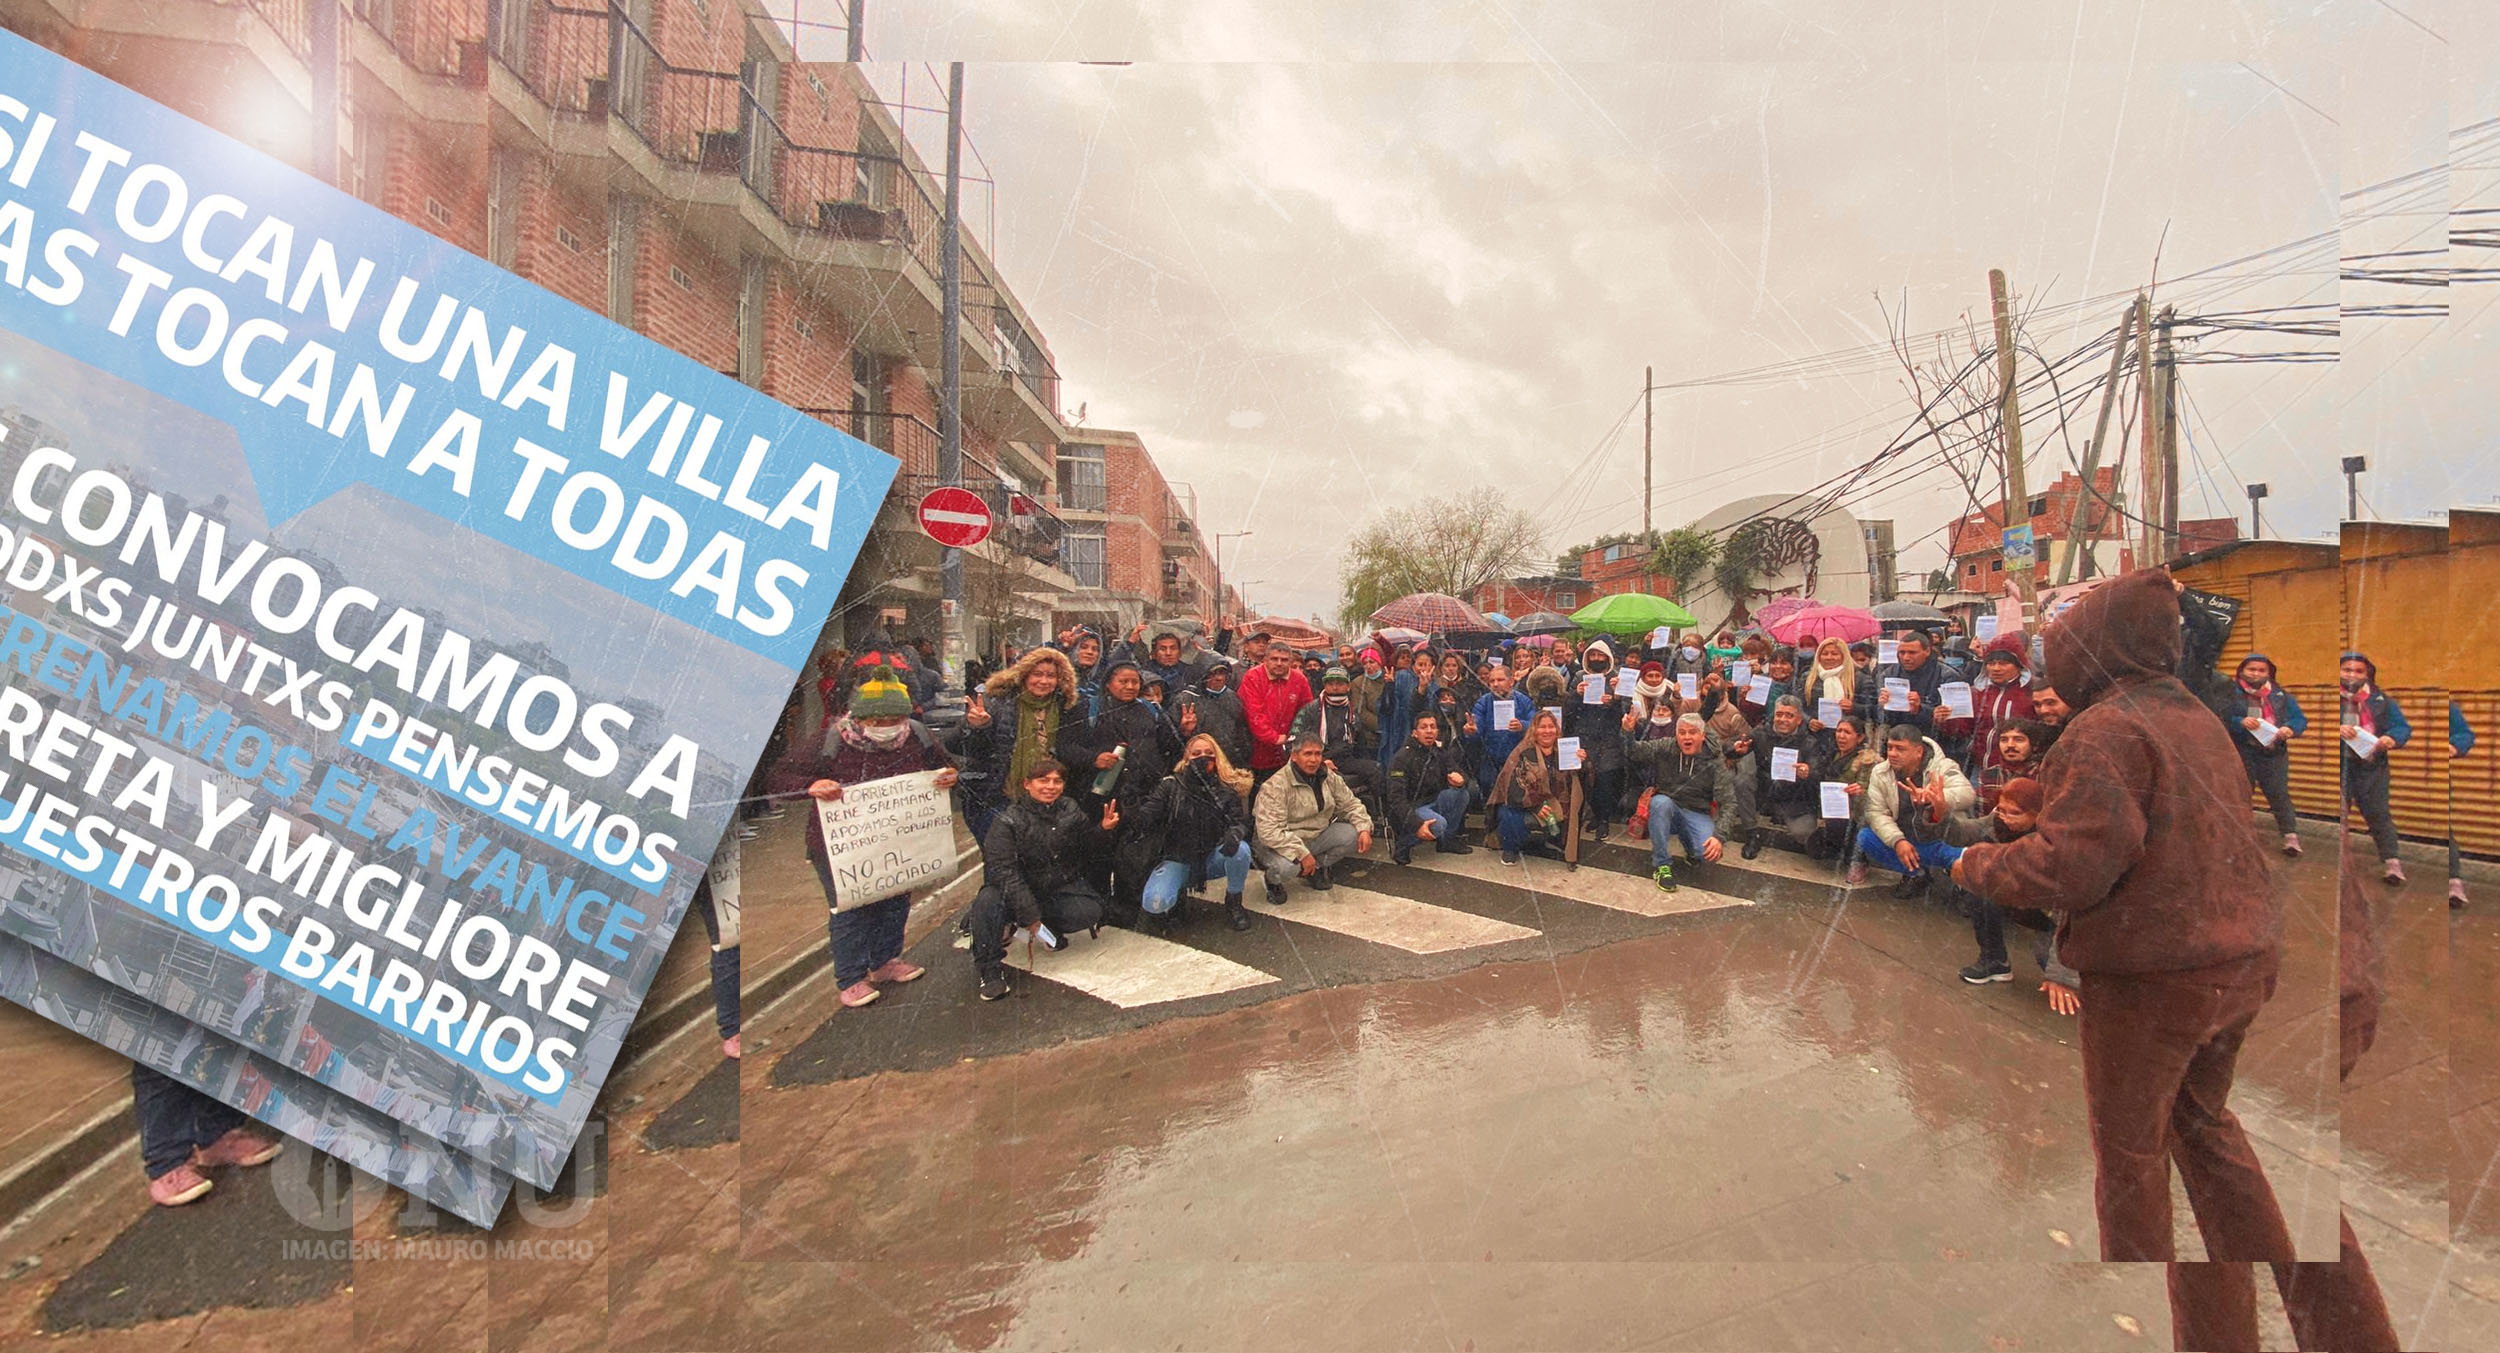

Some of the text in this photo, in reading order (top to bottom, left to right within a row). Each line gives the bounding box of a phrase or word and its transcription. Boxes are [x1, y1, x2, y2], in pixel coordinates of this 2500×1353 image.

[826, 789, 942, 823] RENE SALAMANCA
[841, 780, 914, 805] CORRIENTE
[830, 805, 936, 841] APOYAMOS A LOS
[830, 816, 952, 856] BARRIOS POPULARES
[839, 851, 912, 888] NO AL
[850, 858, 943, 901] NEGOCIADO
